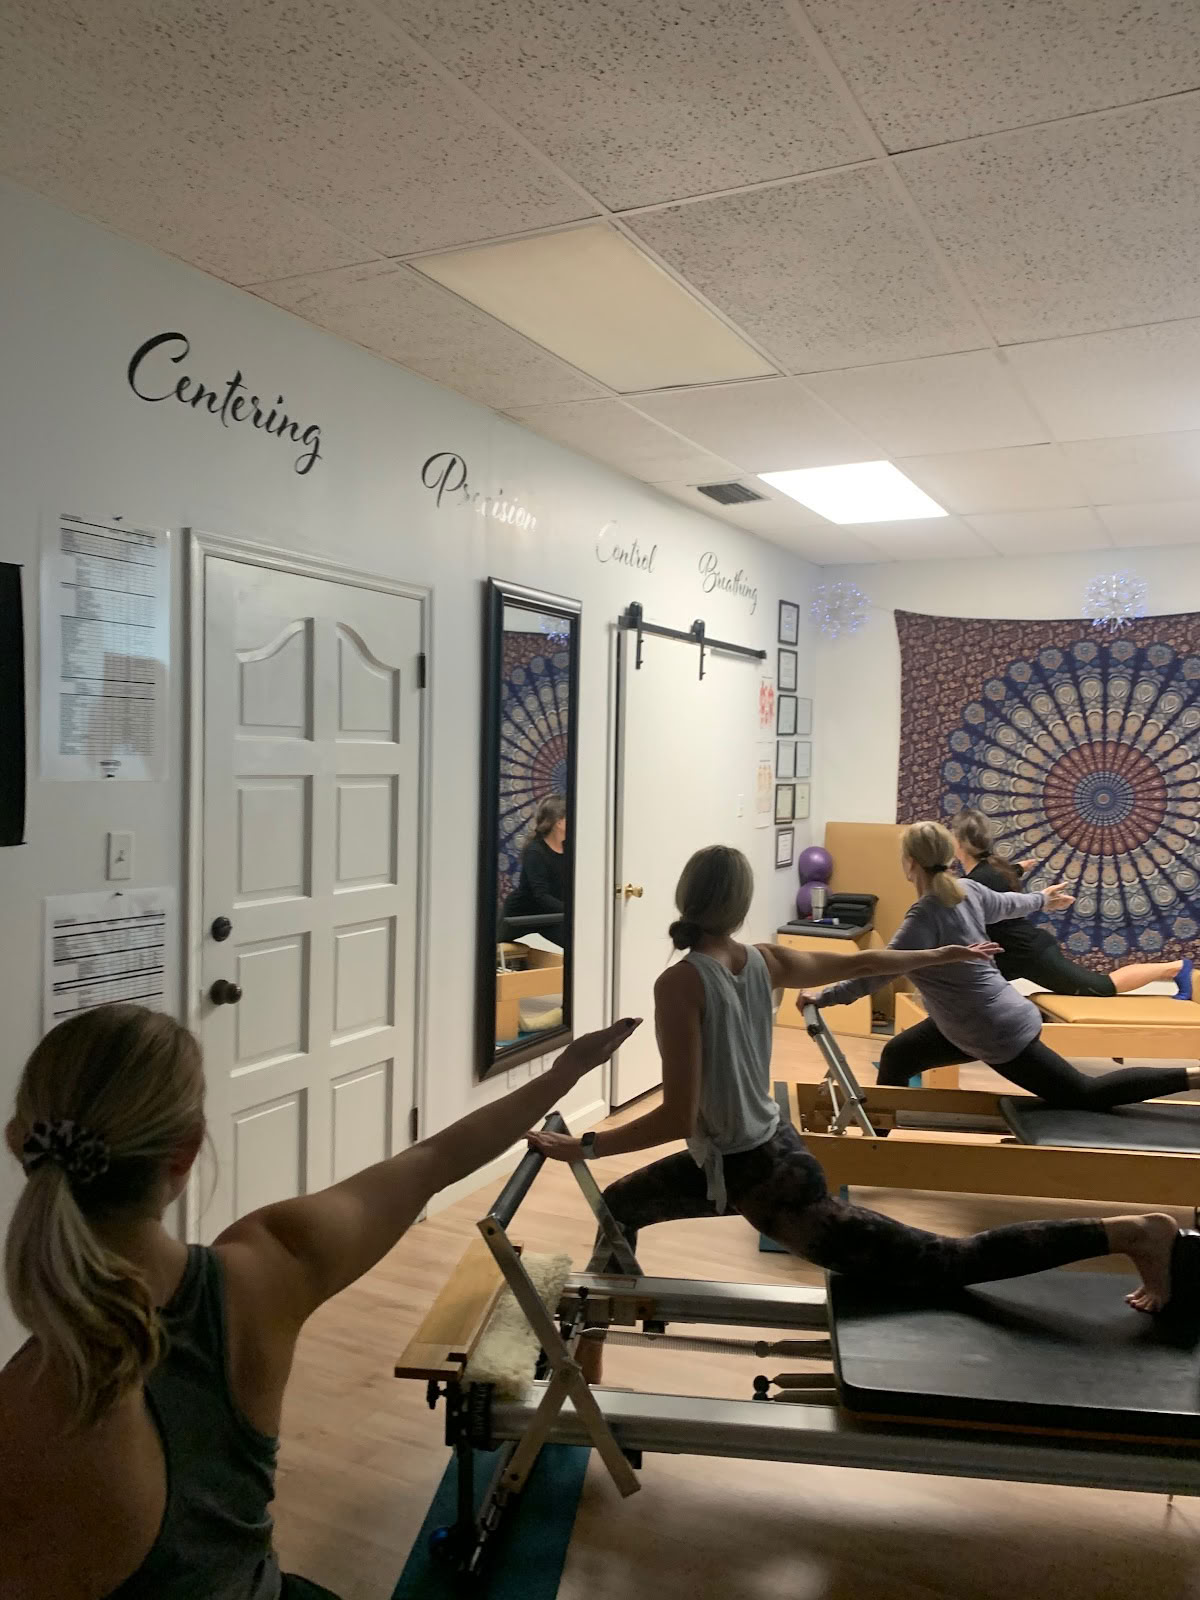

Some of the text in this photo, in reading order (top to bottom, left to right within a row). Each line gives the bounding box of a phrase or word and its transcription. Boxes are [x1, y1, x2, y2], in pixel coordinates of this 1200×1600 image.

[127, 331, 323, 476] Centering
[595, 519, 658, 574] Control
[698, 551, 758, 616] Breathing
